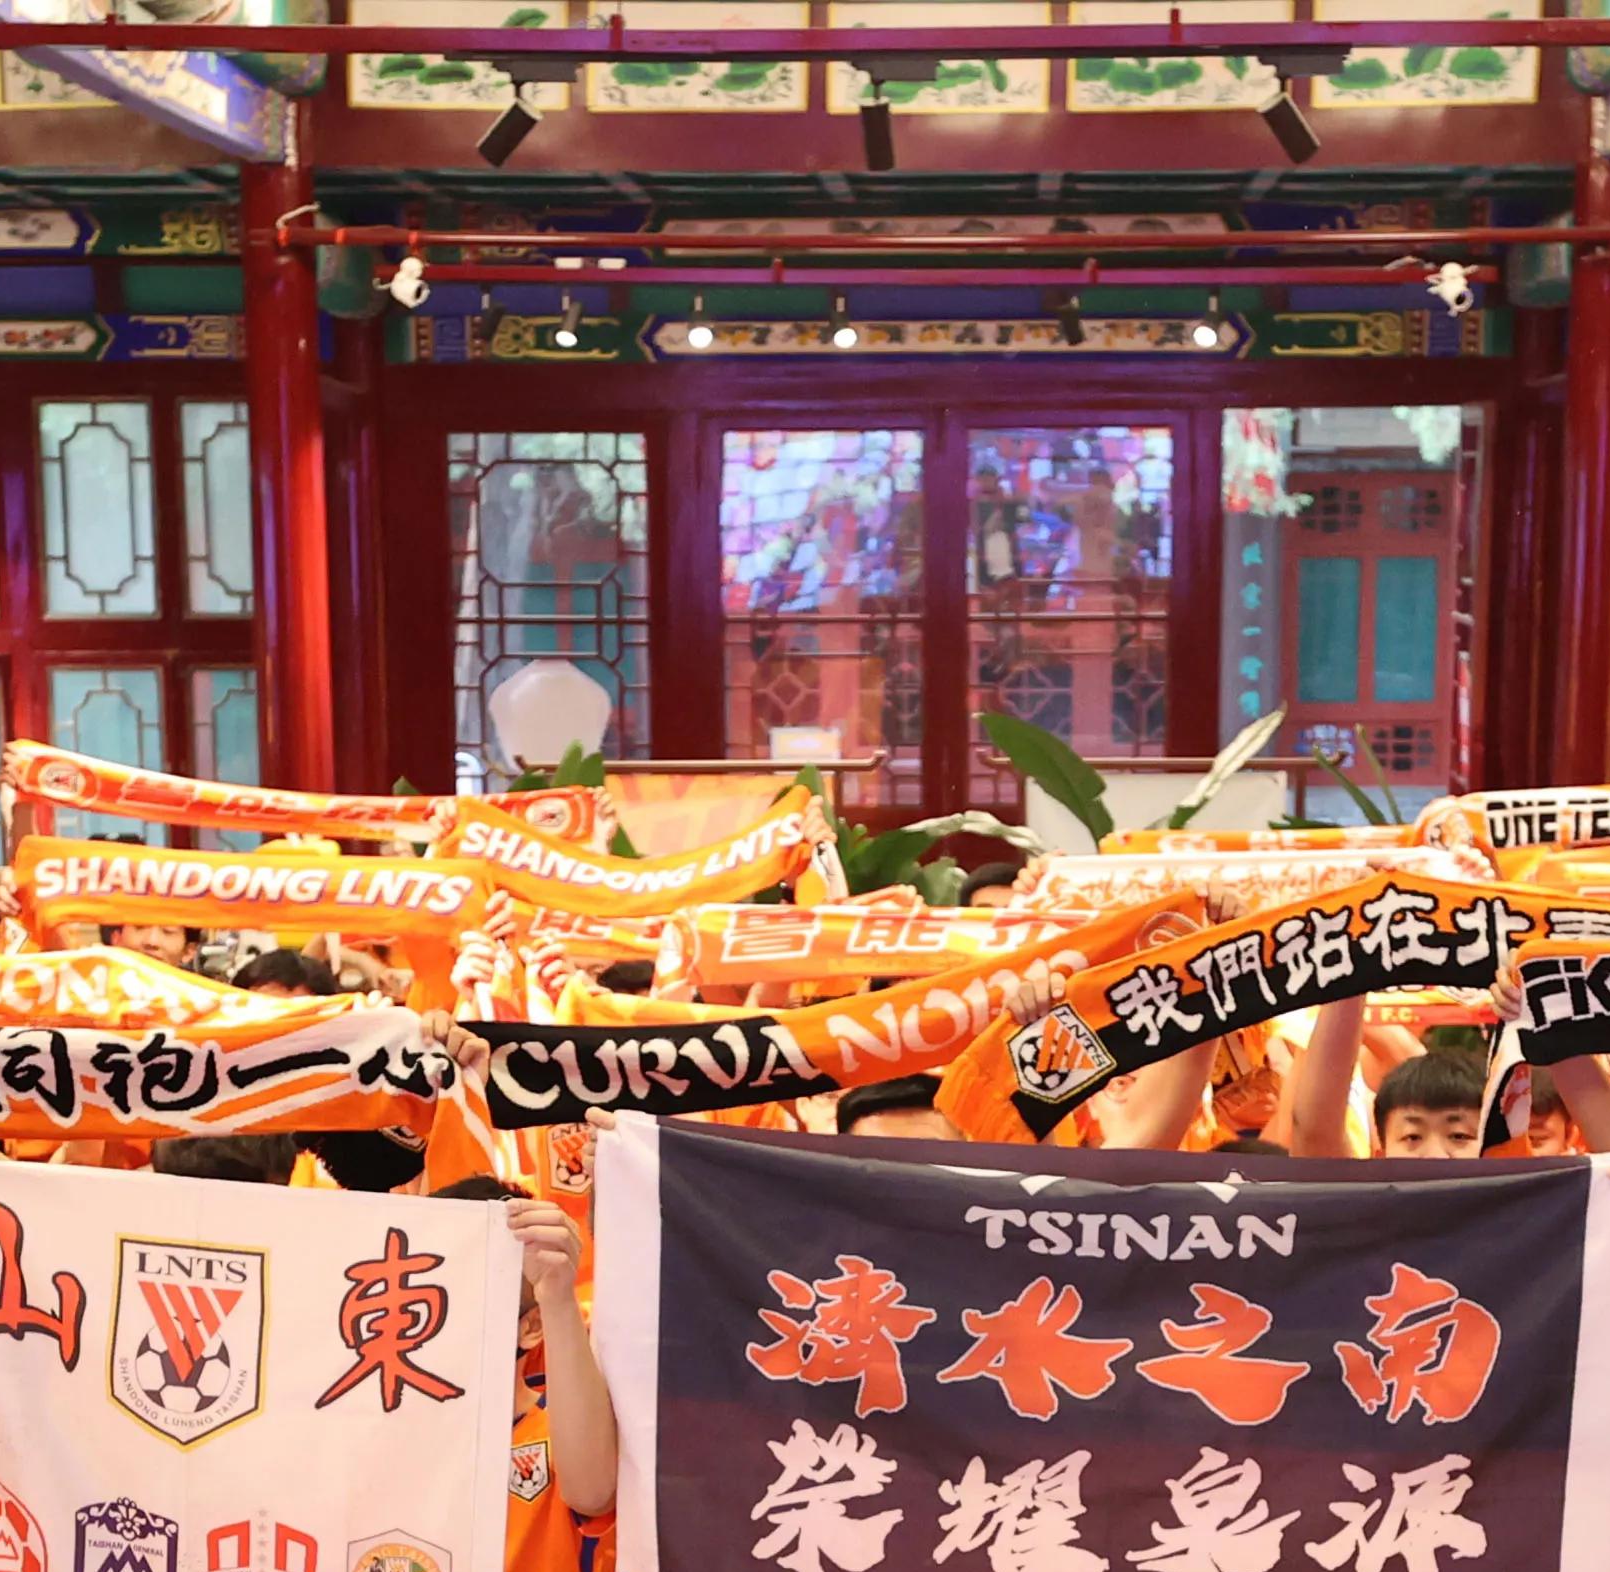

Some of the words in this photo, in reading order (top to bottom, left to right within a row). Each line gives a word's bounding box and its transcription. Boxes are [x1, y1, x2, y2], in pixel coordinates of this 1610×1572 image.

[459, 819, 694, 895] SHANDONG
[702, 811, 804, 879] LNTS
[34, 856, 328, 904] SHANDONG
[335, 869, 473, 916] LNTS
[1054, 1006, 1109, 1070] LNTS
[1380, 1007, 1421, 1024] F.C.
[489, 1023, 823, 1111] CURVA
[962, 1202, 1299, 1263] TSINAN
[134, 1250, 249, 1284] LNTS
[313, 1225, 467, 1413] 東
[118, 1356, 159, 1421] SHANDONG
[163, 1412, 215, 1430] LUNENG
[215, 1368, 248, 1419] TAISHAN
